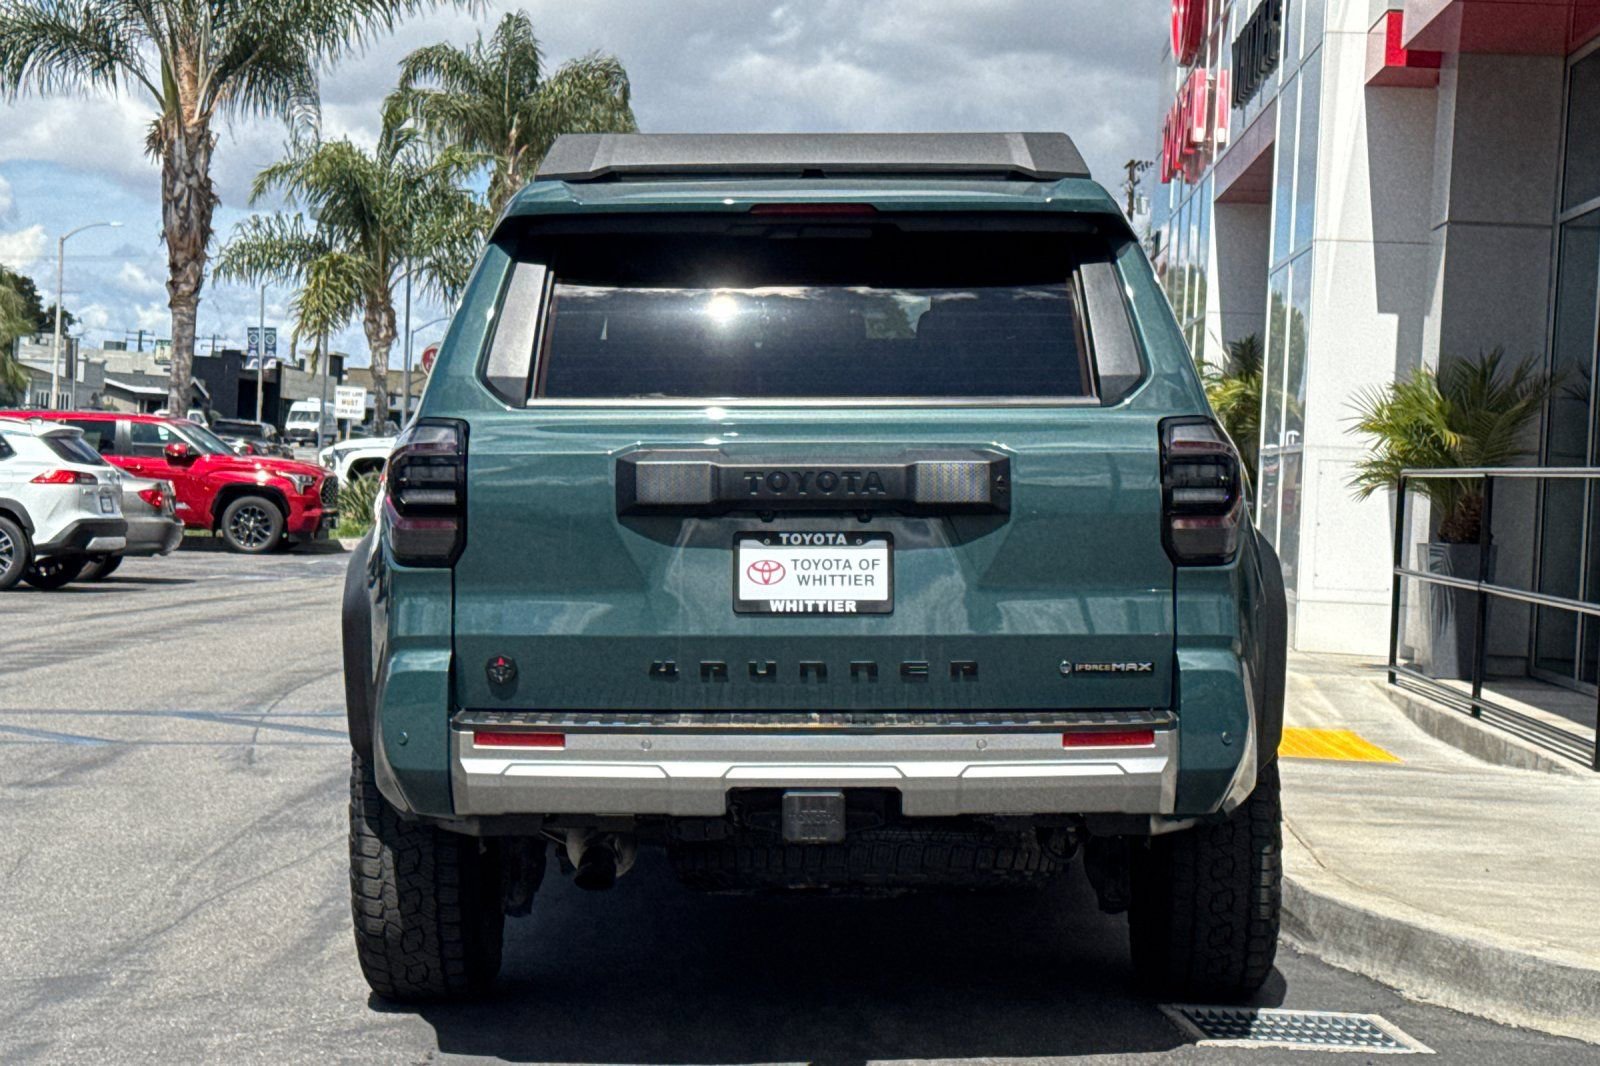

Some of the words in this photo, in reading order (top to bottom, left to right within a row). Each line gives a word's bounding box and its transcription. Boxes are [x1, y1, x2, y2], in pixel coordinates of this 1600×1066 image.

[744, 471, 886, 495] TOYOTA
[779, 533, 847, 545] TOYOTA
[791, 558, 852, 571] TOYOTA
[858, 558, 881, 571] OF
[797, 574, 875, 587] WHITTIER
[769, 600, 857, 613] WHITTIER
[649, 660, 979, 683] 4RUNNER
